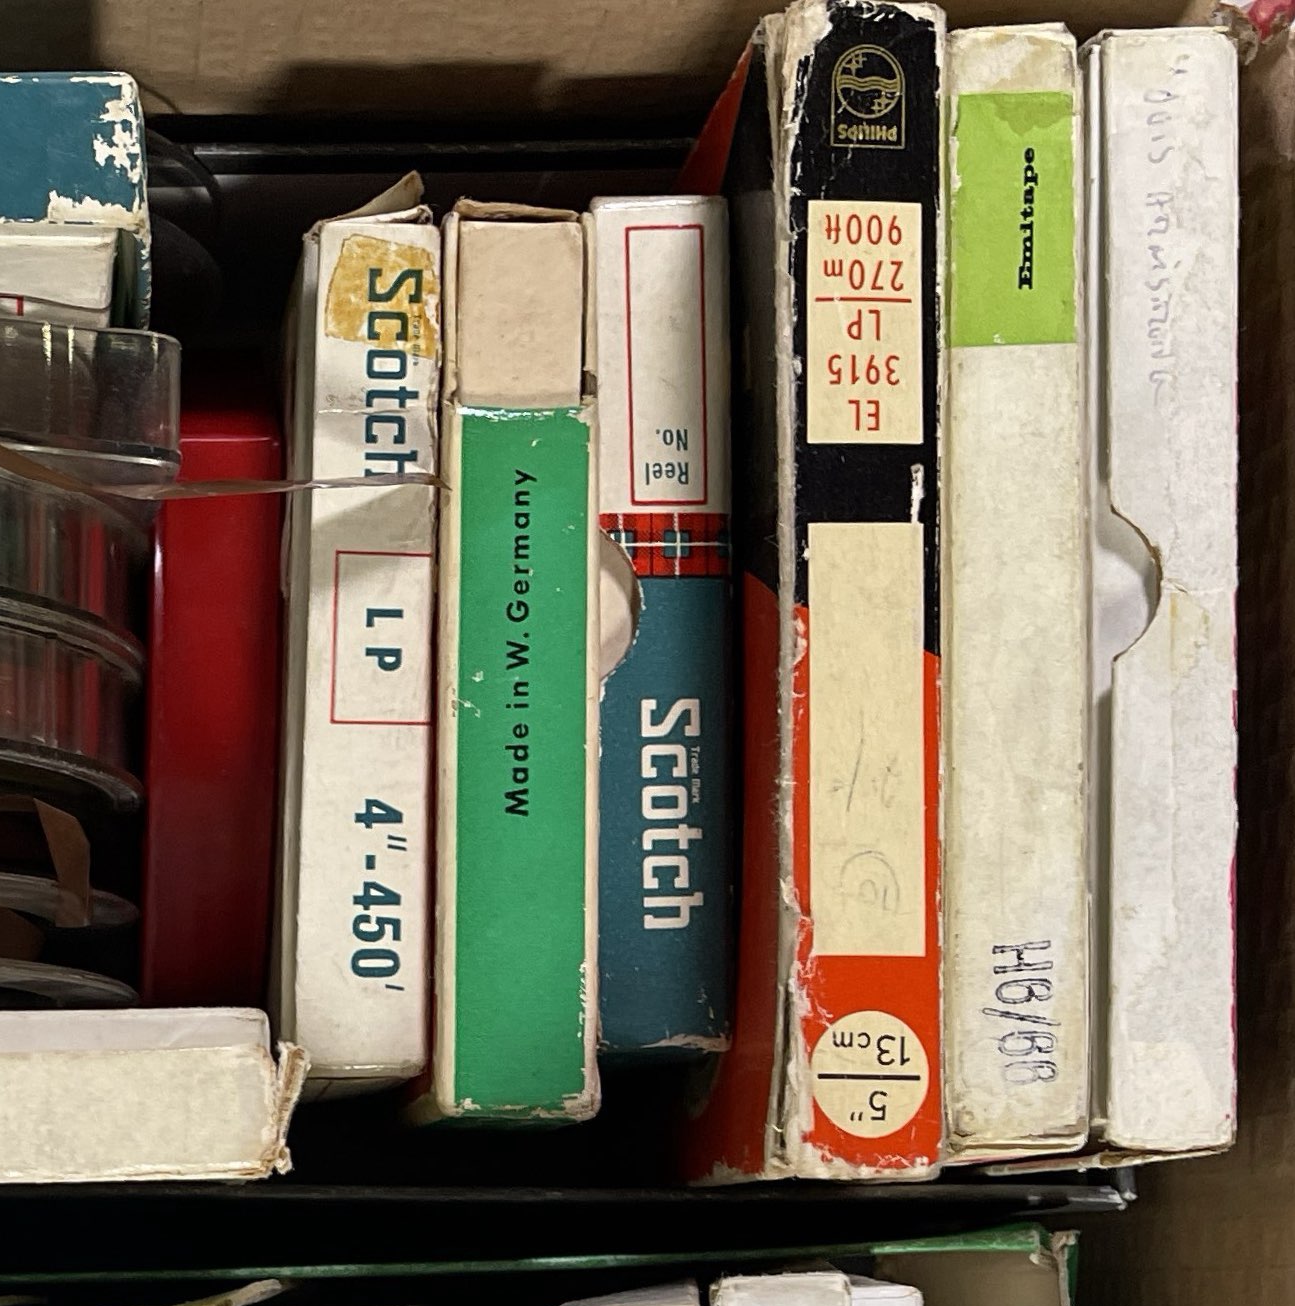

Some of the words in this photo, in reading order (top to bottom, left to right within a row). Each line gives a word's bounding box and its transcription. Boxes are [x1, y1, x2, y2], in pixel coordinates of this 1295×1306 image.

[837, 123, 898, 141] PHILIPS
[826, 214, 901, 245] 900ft
[1019, 148, 1038, 289] Emitape
[824, 260, 903, 291] 270m
[848, 309, 880, 341] LP
[364, 267, 424, 478] Scotch
[828, 355, 899, 385] 3915
[848, 400, 879, 431] EL
[657, 429, 688, 451] No.
[646, 461, 689, 485] Reel
[507, 470, 537, 622] Germany
[506, 634, 530, 670] W.
[506, 682, 529, 708] in
[505, 723, 530, 817] Made
[690, 746, 700, 775] Trade
[640, 698, 703, 930] Scotch
